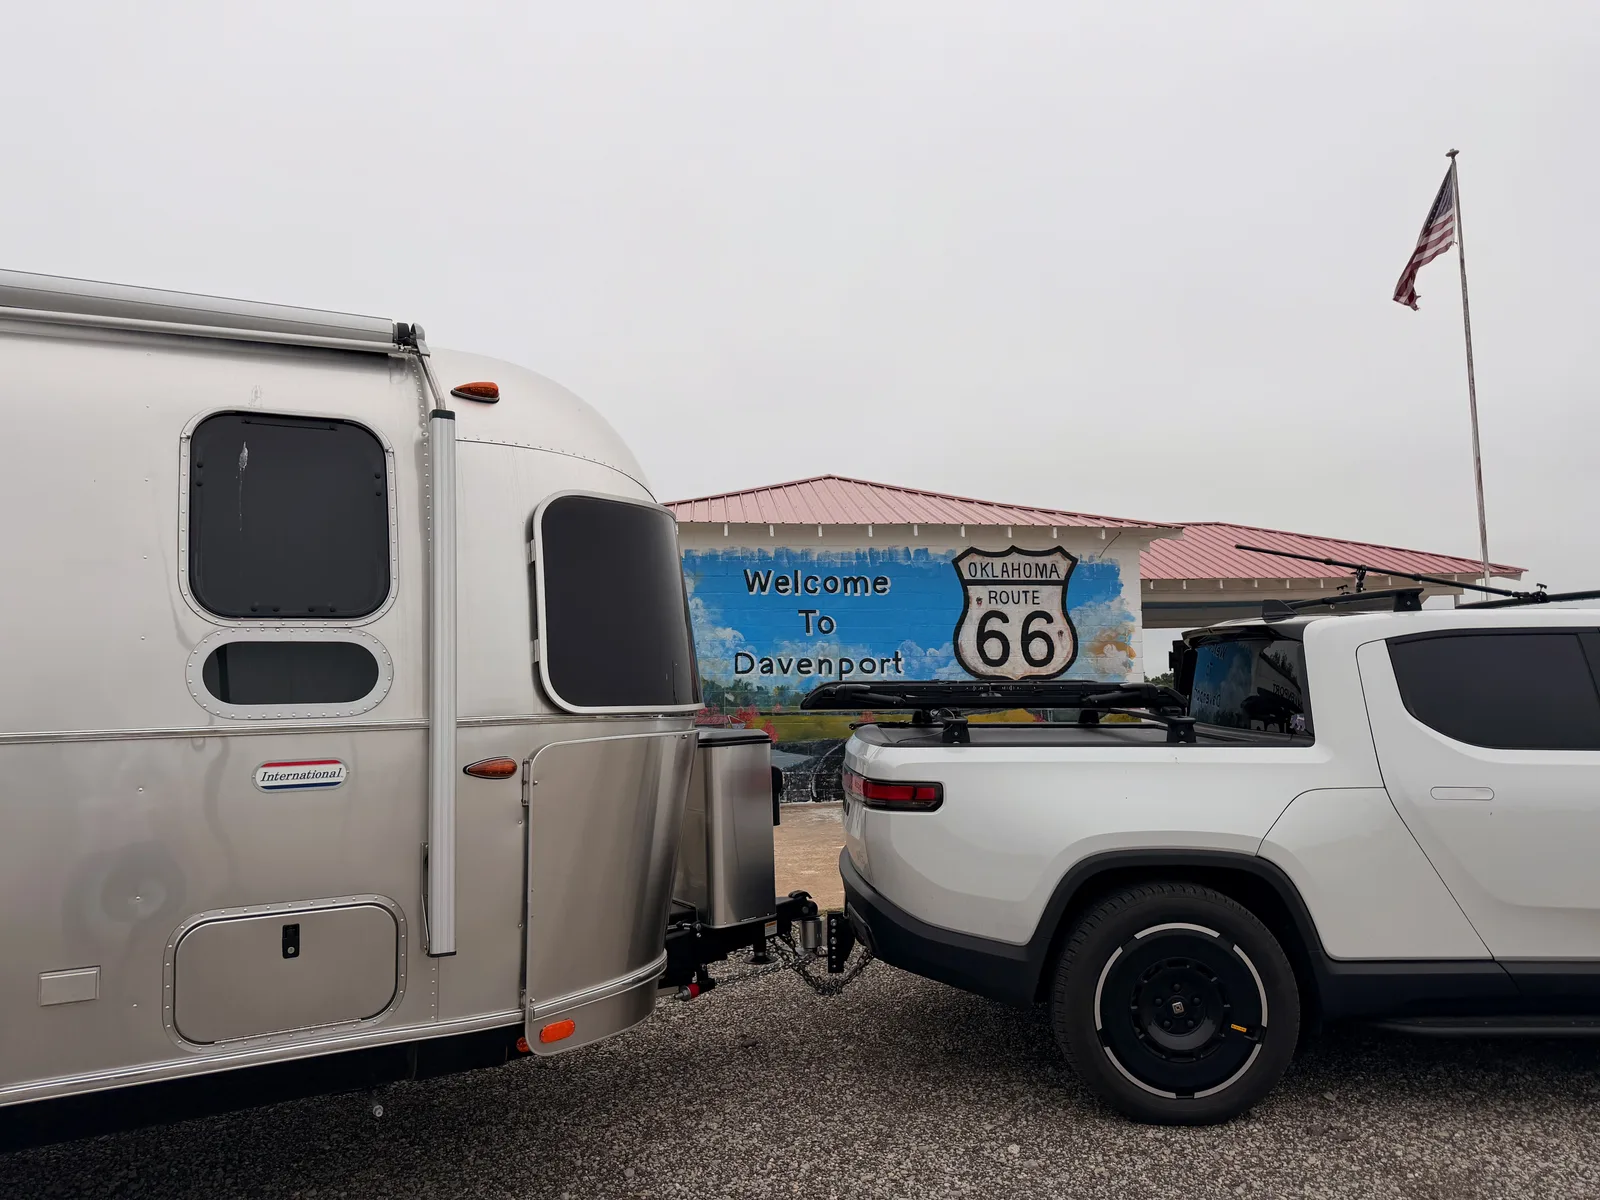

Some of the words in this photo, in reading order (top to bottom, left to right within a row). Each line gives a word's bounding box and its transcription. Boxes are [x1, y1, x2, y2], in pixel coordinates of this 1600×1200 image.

[743, 568, 891, 596] Welcome
[968, 562, 1060, 578] OKLAHOMA
[988, 590, 1040, 605] ROUTE
[798, 609, 836, 636] To
[976, 610, 1054, 667] 66
[734, 650, 905, 681] Davenport
[260, 768, 343, 781] International
